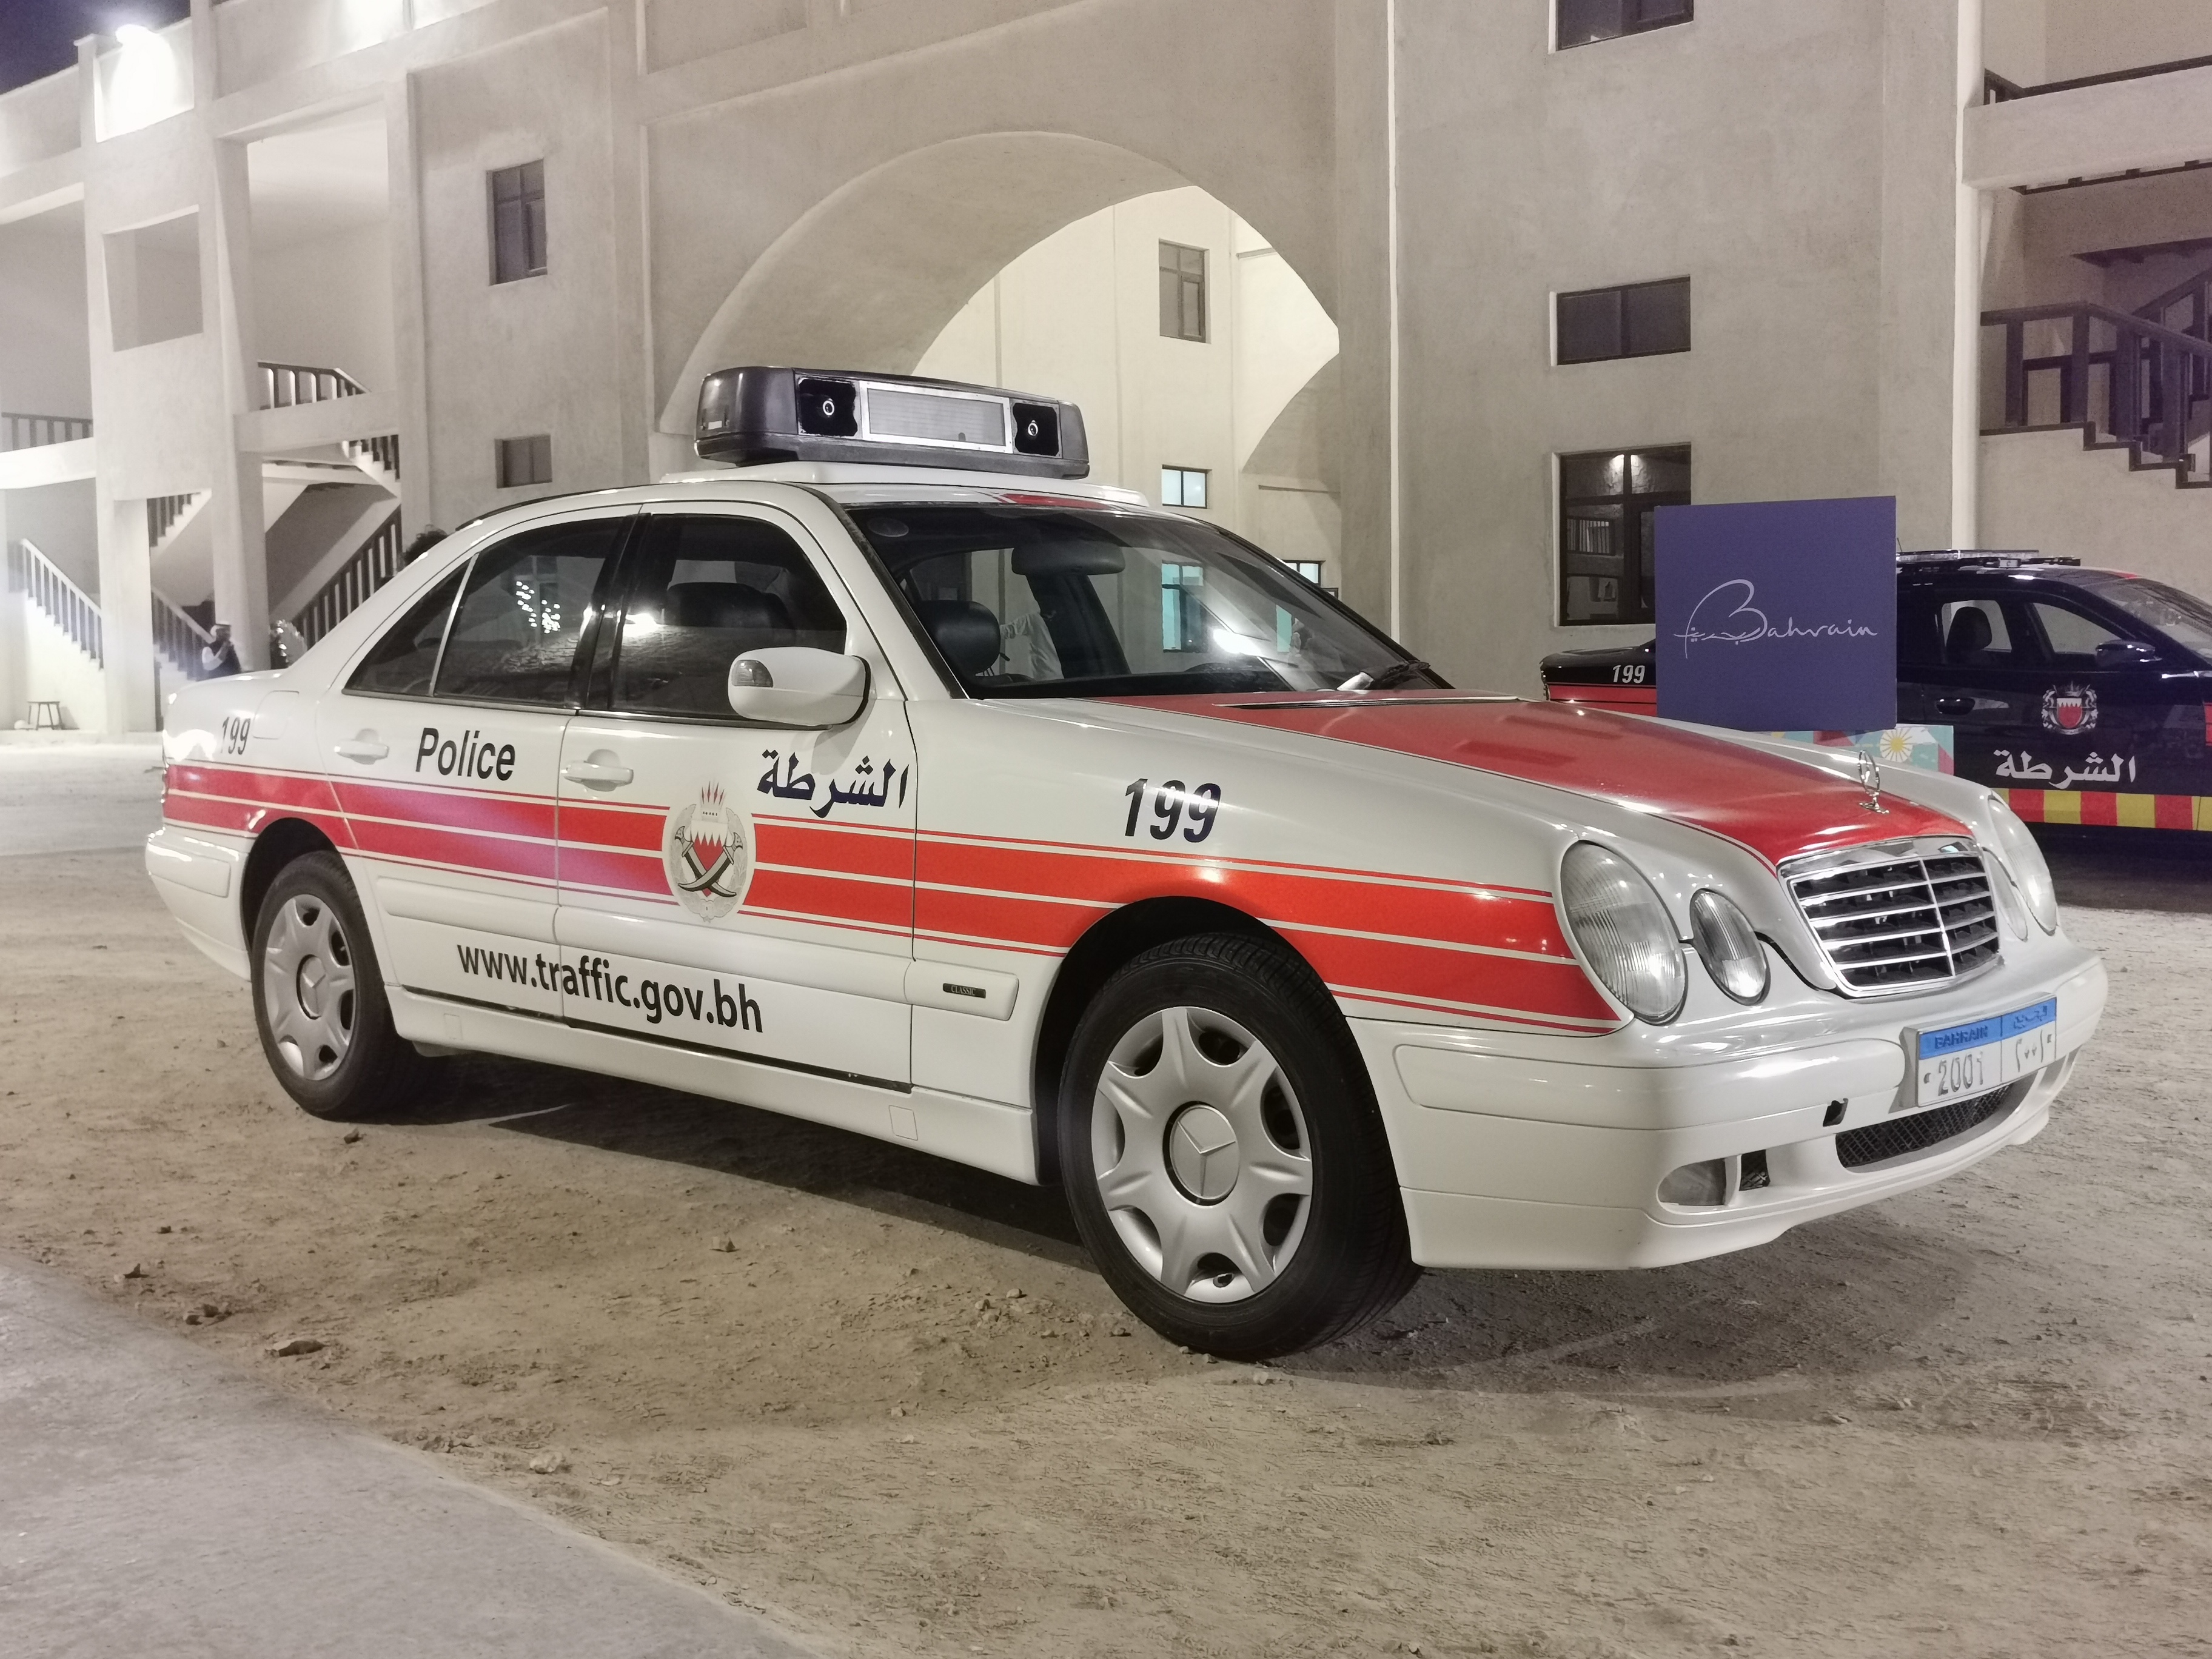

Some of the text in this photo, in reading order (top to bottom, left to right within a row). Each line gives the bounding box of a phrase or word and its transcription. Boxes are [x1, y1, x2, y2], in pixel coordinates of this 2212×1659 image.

[1680, 579, 1878, 659] Bahrain
[1613, 665, 1646, 683] 199
[220, 717, 251, 755] 199
[415, 728, 516, 782] Police
[757, 749, 910, 819] الشرطة
[1993, 749, 2136, 789] الشرطة
[1125, 778, 1221, 843] 199
[457, 944, 763, 1033] www.traffic.gov.bh
[951, 985, 976, 996] CLASSIC
[1934, 1025, 1988, 1050] BAHRAIN
[1937, 1050, 1983, 1096] 2001
